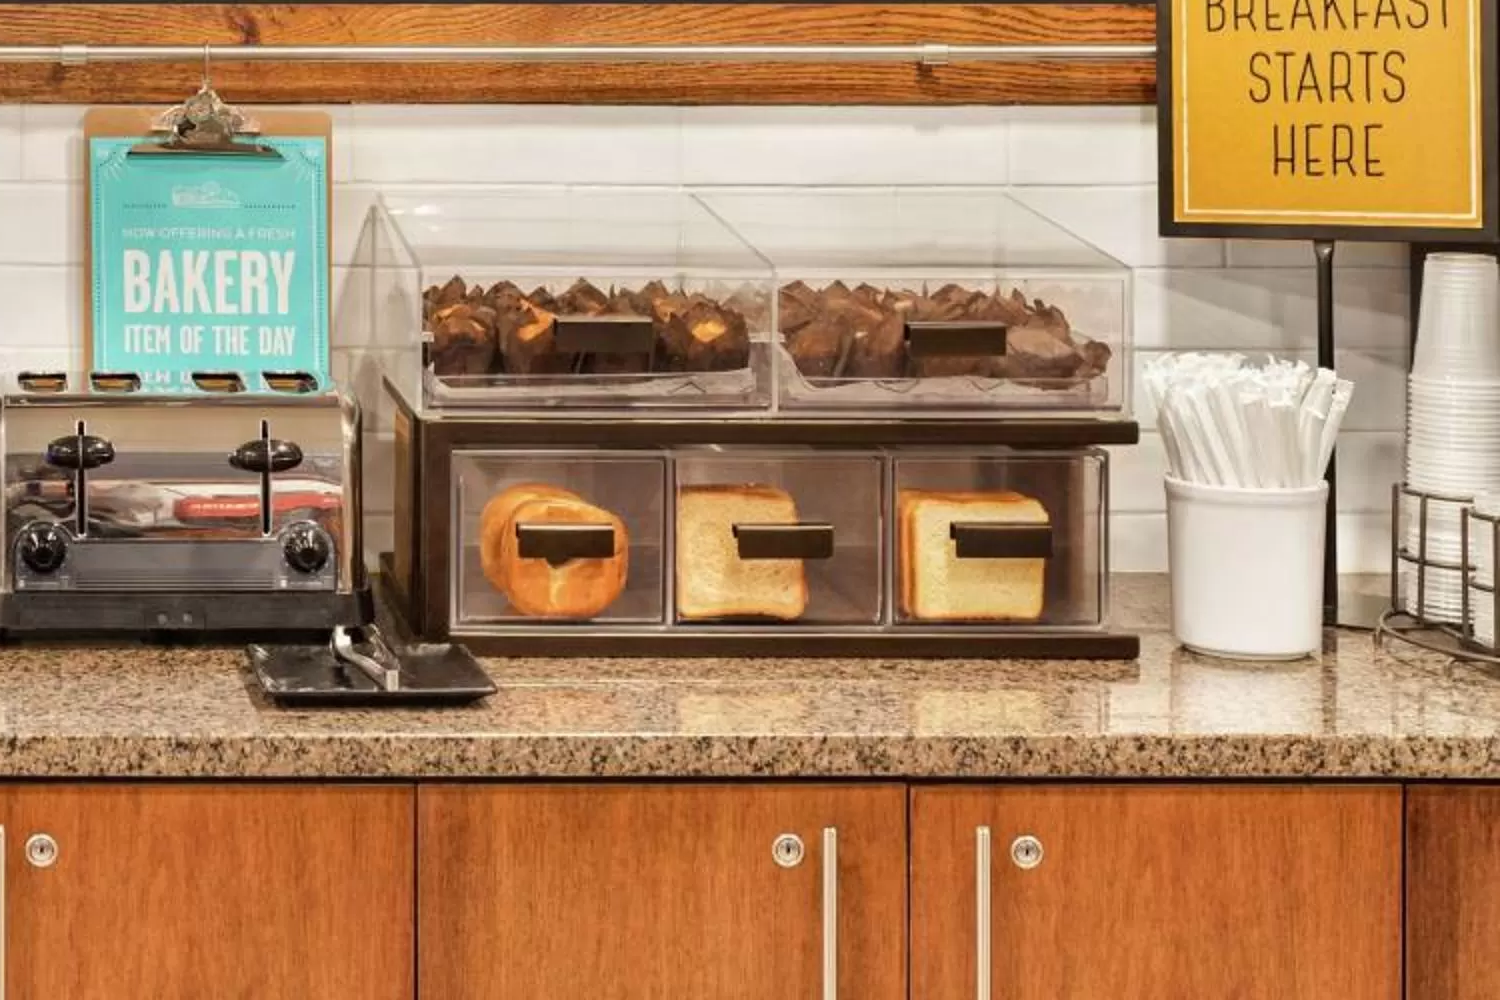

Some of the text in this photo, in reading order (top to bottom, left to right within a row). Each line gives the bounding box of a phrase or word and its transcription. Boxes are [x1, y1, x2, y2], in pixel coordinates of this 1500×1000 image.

[1248, 51, 1406, 104] STARTS
[1273, 123, 1385, 177] HERE
[123, 249, 296, 315] BAKERY
[124, 324, 296, 357] ITEM OF THE DAY
